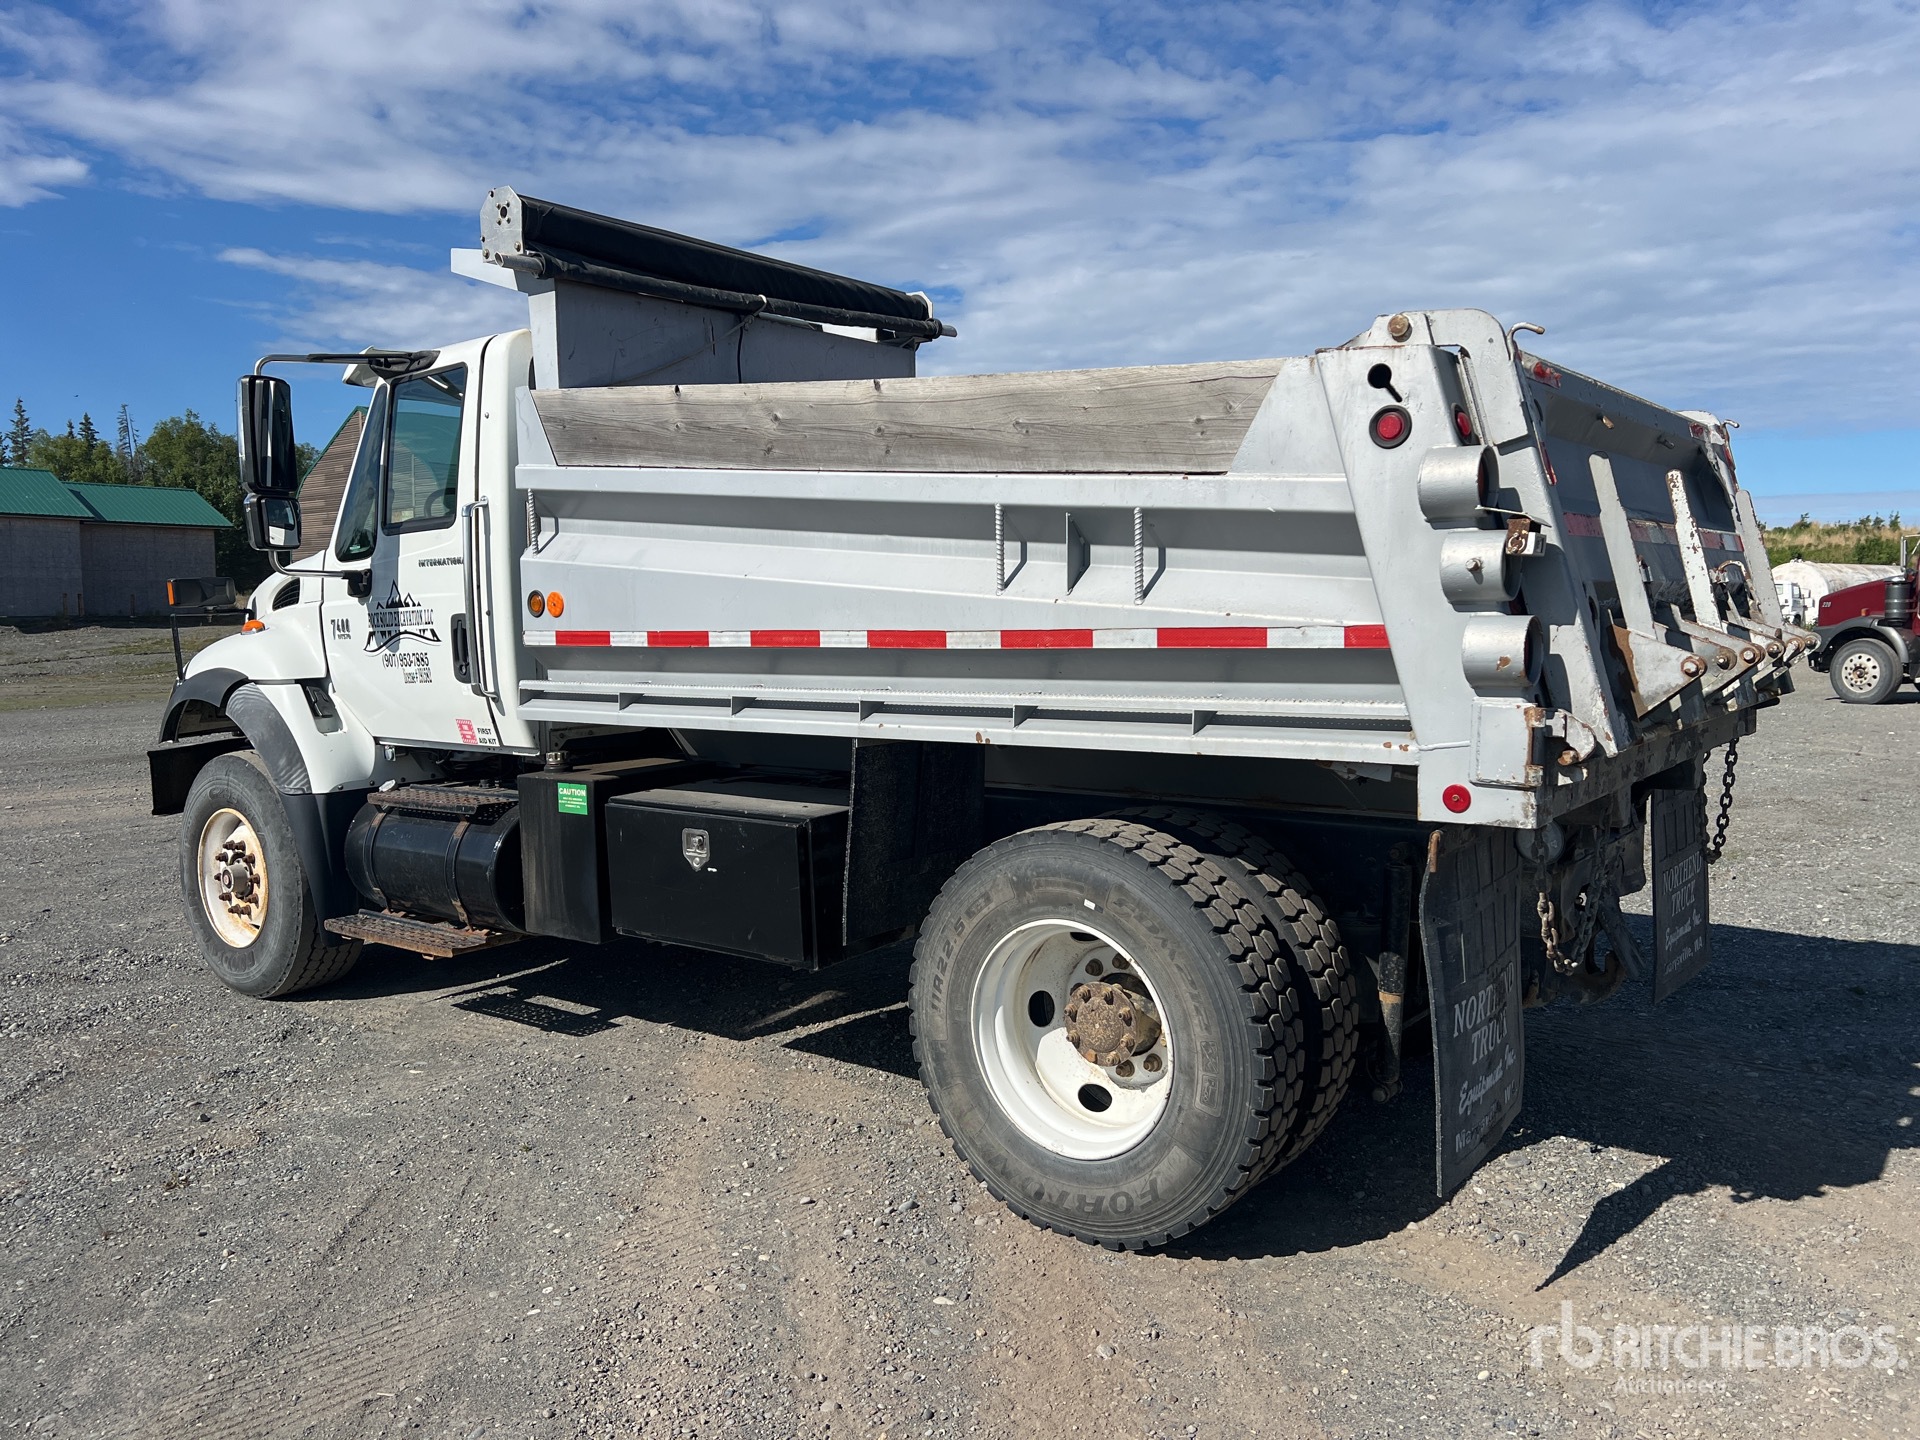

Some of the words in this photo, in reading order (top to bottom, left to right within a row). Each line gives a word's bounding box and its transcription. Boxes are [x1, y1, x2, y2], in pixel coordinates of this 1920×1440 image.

[330, 618, 350, 640] 7400
[477, 727, 492, 735] FIRST
[559, 788, 586, 796] CAUTION
[1671, 879, 1696, 917] TRUCK
[1454, 961, 1514, 1038] NORTND
[978, 1140, 1163, 1217] FORTUN
